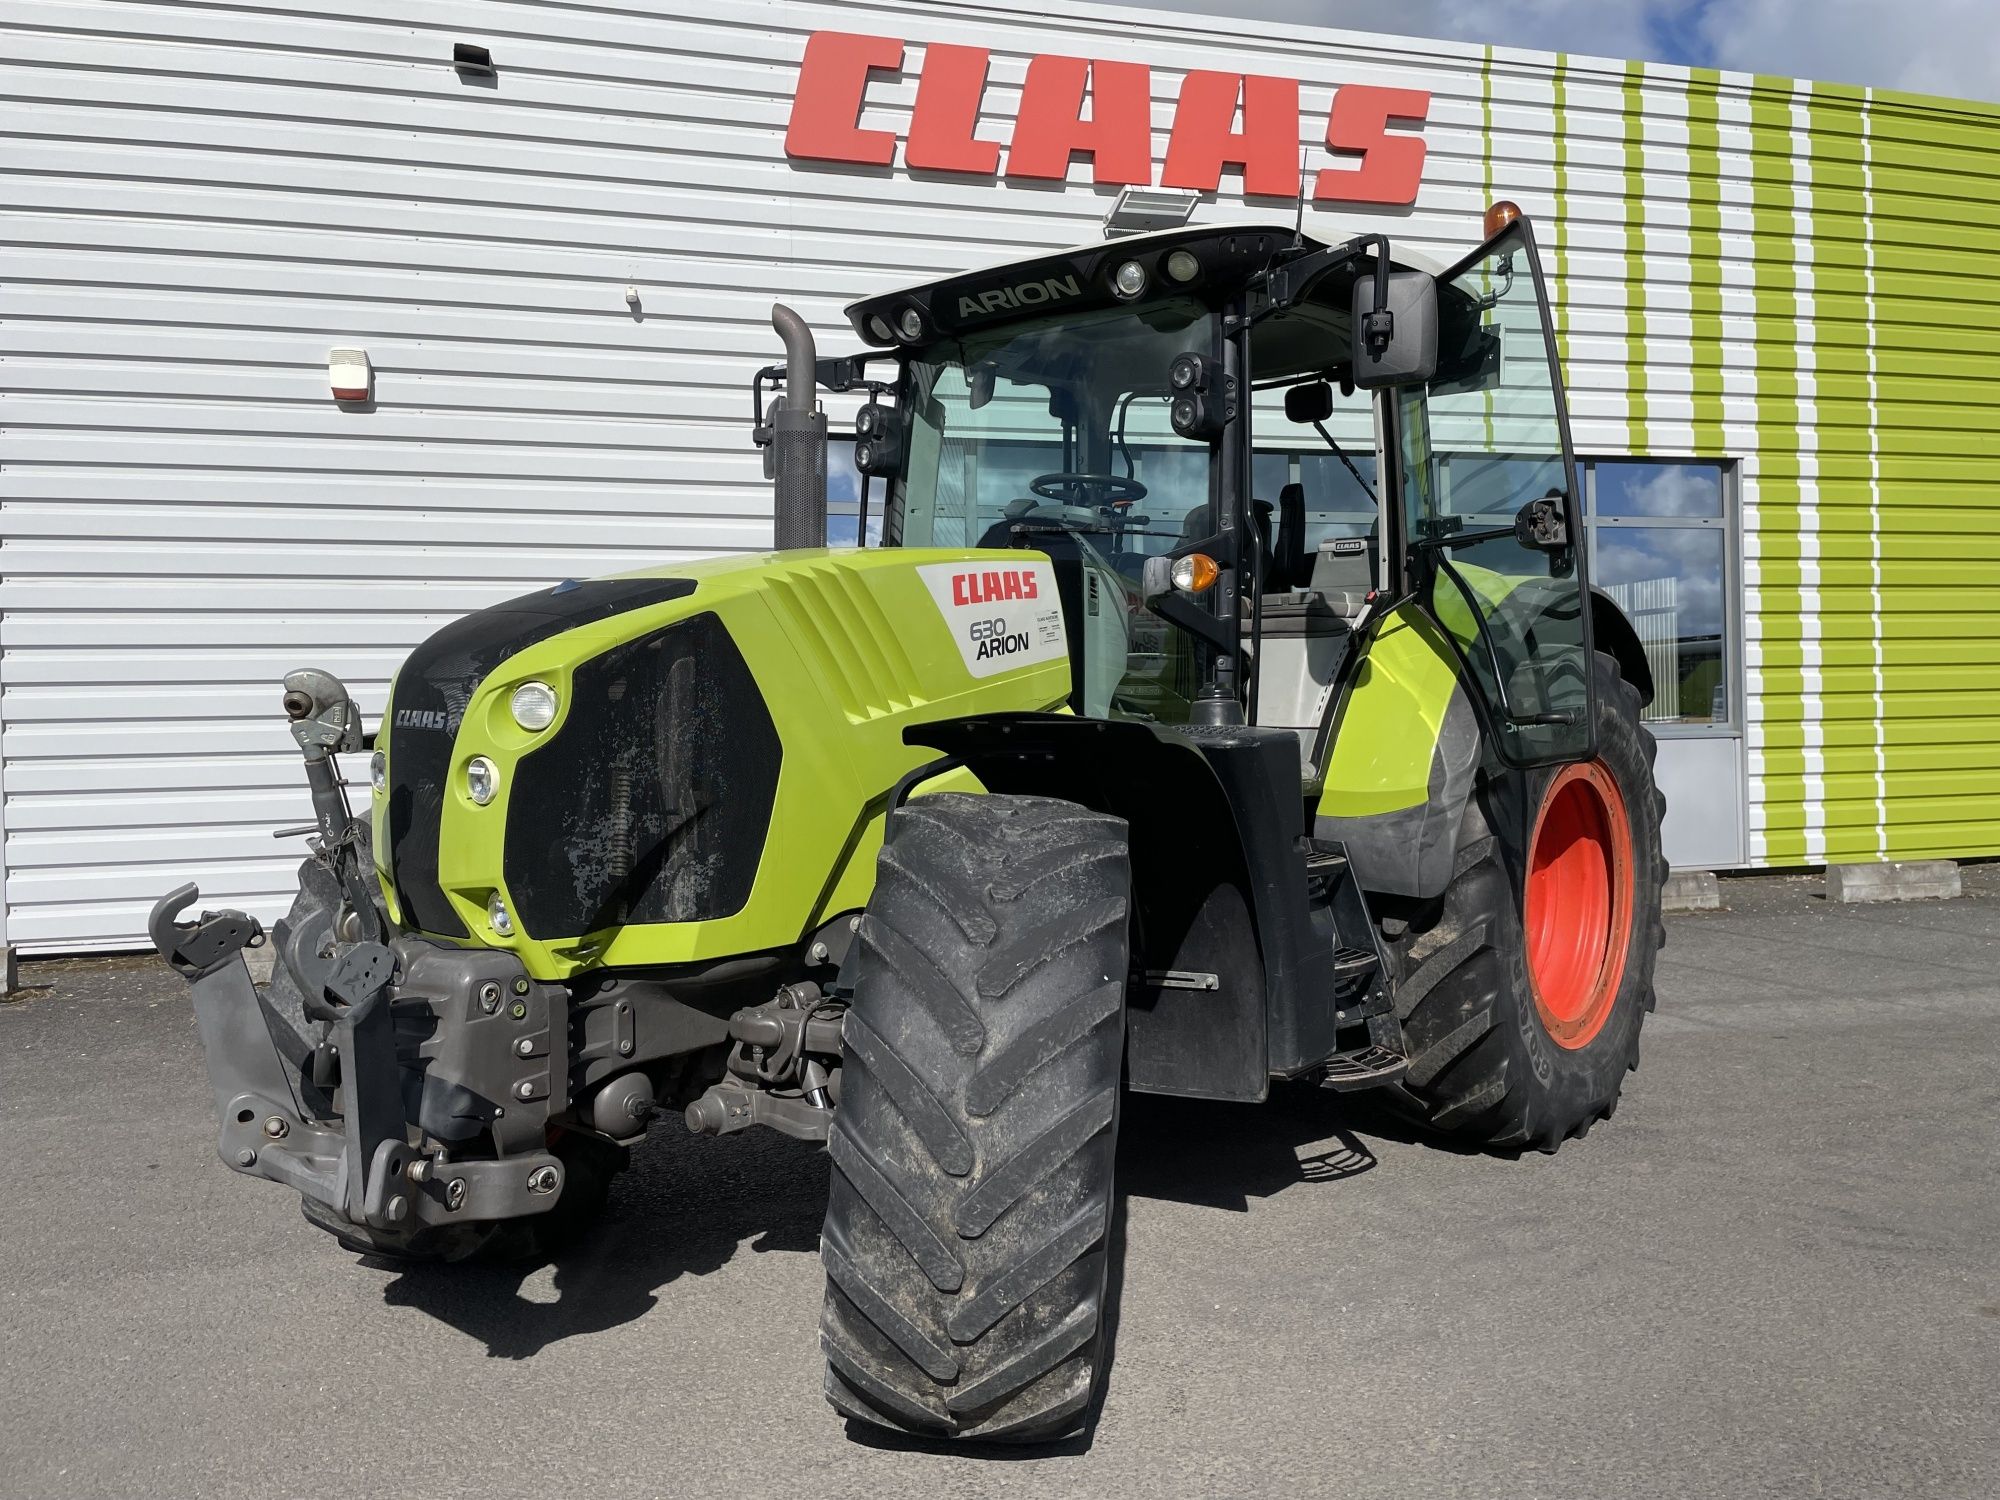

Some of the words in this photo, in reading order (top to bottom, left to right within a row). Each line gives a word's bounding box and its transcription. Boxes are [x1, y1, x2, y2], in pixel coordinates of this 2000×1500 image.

[785, 31, 1431, 203] CLAAS
[958, 275, 1081, 318] ARION
[952, 571, 1037, 606] CLAAS
[970, 618, 1006, 641] 630
[976, 632, 1029, 661] ARION
[396, 709, 447, 729] CLAAS
